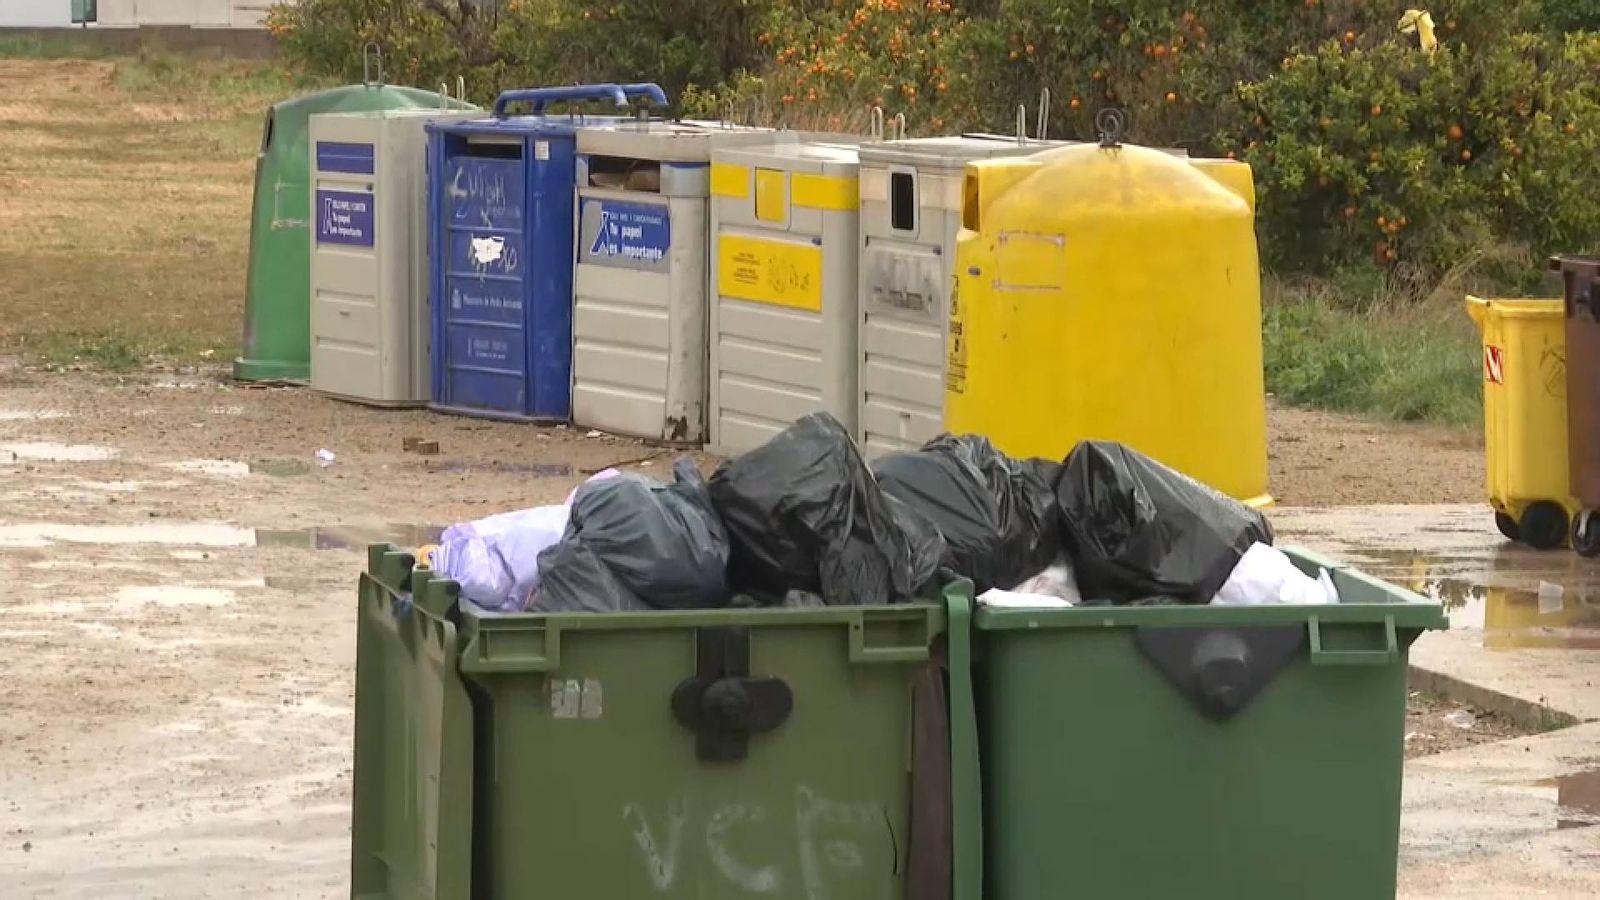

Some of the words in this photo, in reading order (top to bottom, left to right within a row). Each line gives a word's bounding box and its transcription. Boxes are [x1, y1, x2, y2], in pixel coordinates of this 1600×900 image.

[609, 221, 619, 236] Tu
[621, 225, 643, 241] papel
[609, 243, 618, 255] es
[621, 241, 663, 261] importante
